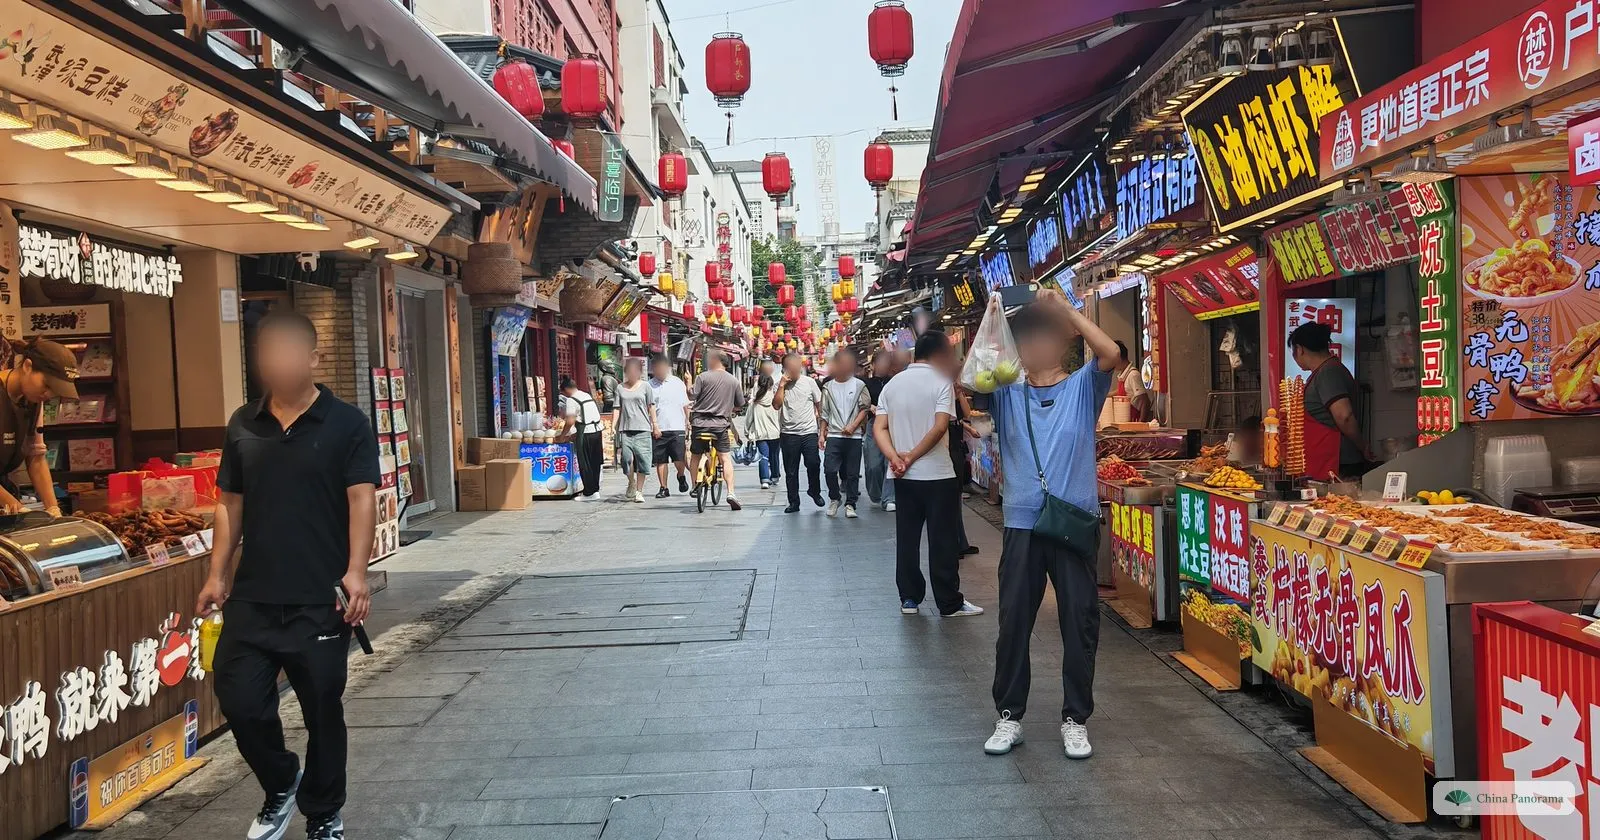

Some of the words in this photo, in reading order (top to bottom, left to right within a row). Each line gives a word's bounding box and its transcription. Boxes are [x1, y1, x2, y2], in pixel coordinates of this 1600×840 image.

[57, 57, 130, 105] 绿豆糕
[1524, 23, 1549, 87] 楚
[1360, 48, 1490, 152] 更地道更正宗
[604, 145, 622, 213] 七喜临门
[816, 160, 834, 228] 新春吉祥
[1403, 181, 1443, 217] 恩施
[19, 225, 80, 284] 楚有财
[92, 243, 183, 298] 的湖北特产
[1322, 188, 1421, 273] 恩施炕土豆
[1289, 301, 1300, 337] 老武
[1419, 220, 1446, 389] 炕土豆
[1472, 299, 1496, 312] 特价
[1111, 501, 1153, 556] 油焖虾蟹
[1180, 493, 1205, 536] 恩施
[1214, 502, 1243, 549] 汉味
[1178, 533, 1210, 580] 炕土豆
[1211, 545, 1250, 600] 铁板豆腐
[1254, 537, 1270, 630] 泰式
[1271, 543, 1425, 704] 柠檬无骨凤爪
[0, 680, 51, 774] 鸭
[1501, 674, 1585, 840] 老
[101, 741, 175, 808] 祝你百事可乐
